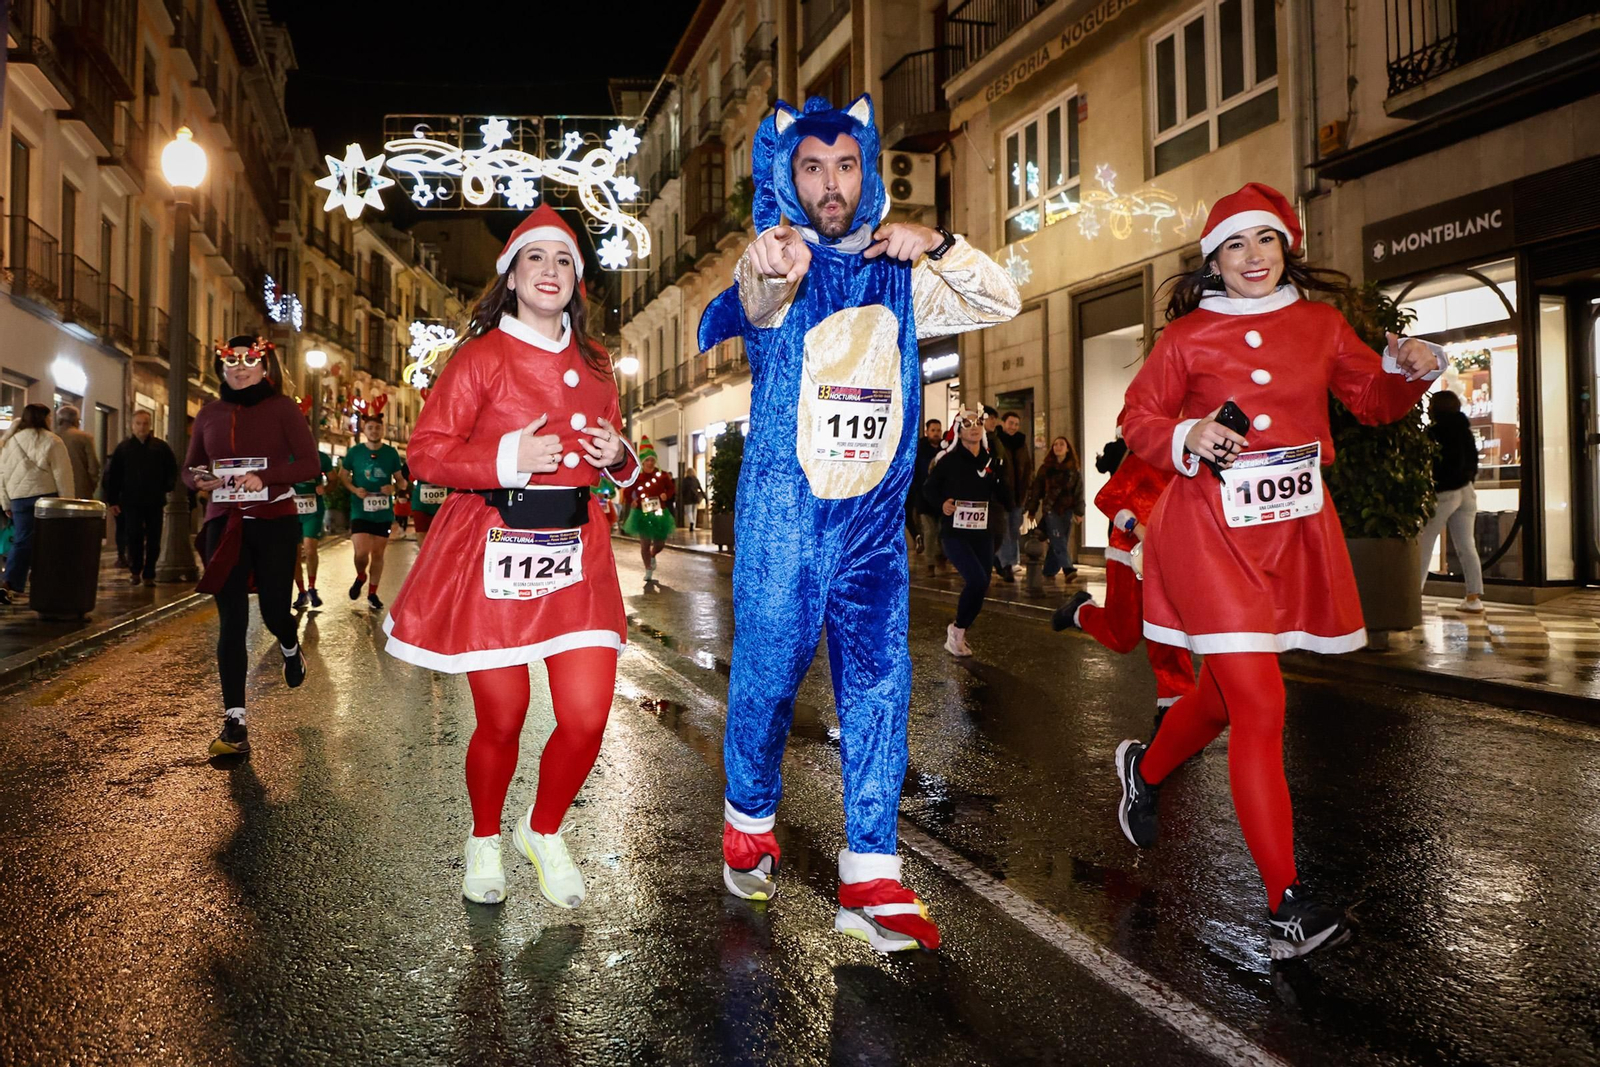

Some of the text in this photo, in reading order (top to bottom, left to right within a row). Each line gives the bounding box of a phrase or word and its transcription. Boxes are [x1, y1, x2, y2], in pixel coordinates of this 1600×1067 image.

[986, 0, 1134, 102] GESTORIA NOGUER
[1392, 209, 1502, 255] MONTBLANC
[819, 385, 831, 399] 33
[829, 394, 861, 402] NOCTURNA
[827, 414, 887, 440] 1197
[1236, 472, 1313, 504] 1098
[423, 491, 445, 500] 1005
[367, 499, 387, 507] 1010
[959, 511, 985, 521] 1702
[490, 529, 502, 542] 33
[501, 536, 534, 544] NOCTURNA
[498, 555, 573, 578] 1124
